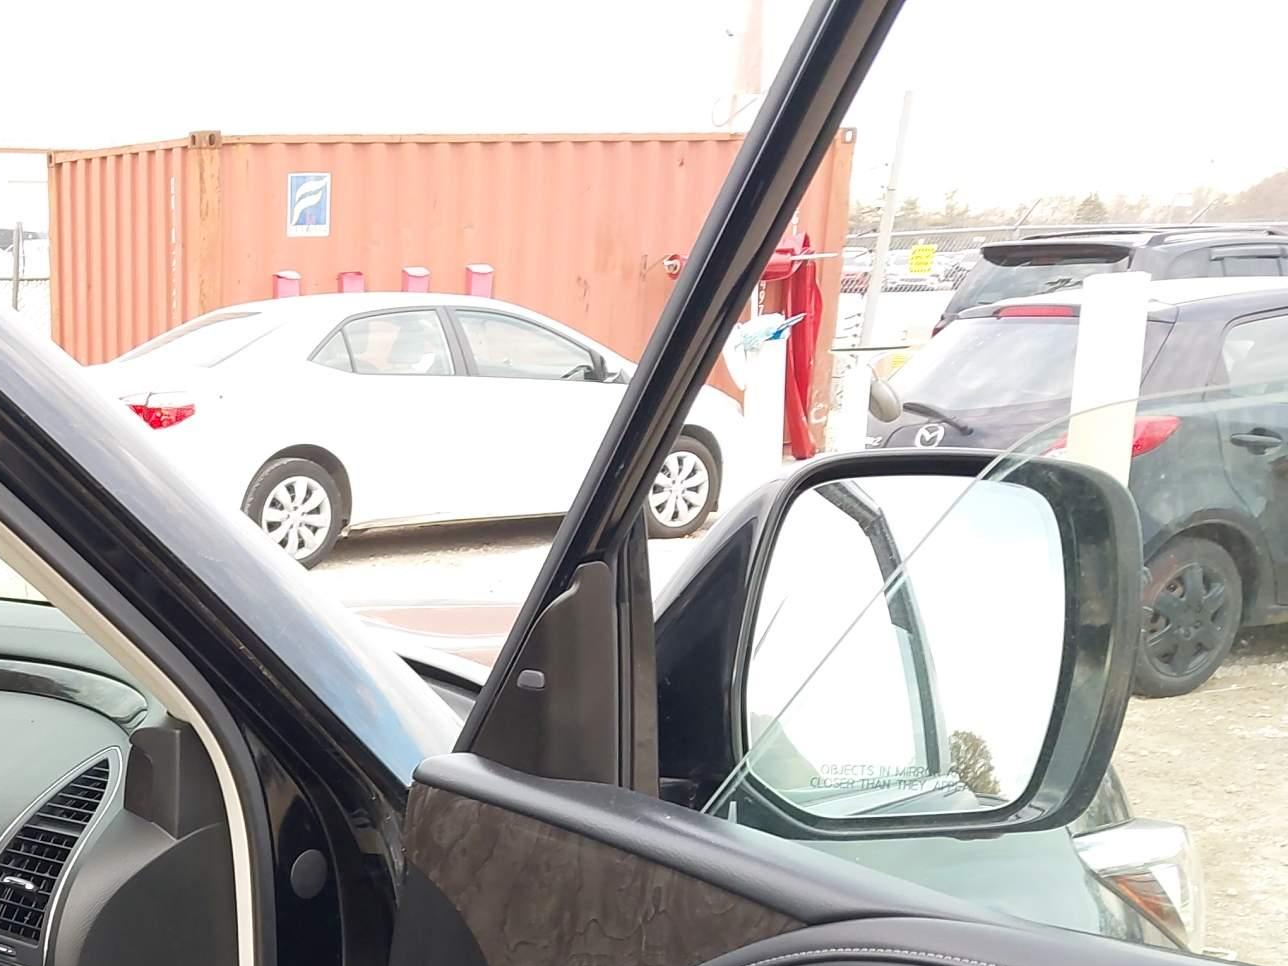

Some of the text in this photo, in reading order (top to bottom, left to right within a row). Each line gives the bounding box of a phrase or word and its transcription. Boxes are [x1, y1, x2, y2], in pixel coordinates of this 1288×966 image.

[820, 763, 874, 776] OBJECTS
[879, 765, 890, 777] IN
[809, 776, 855, 789] CLOSER
[858, 778, 891, 790] THAN
[896, 778, 927, 791] THEY
